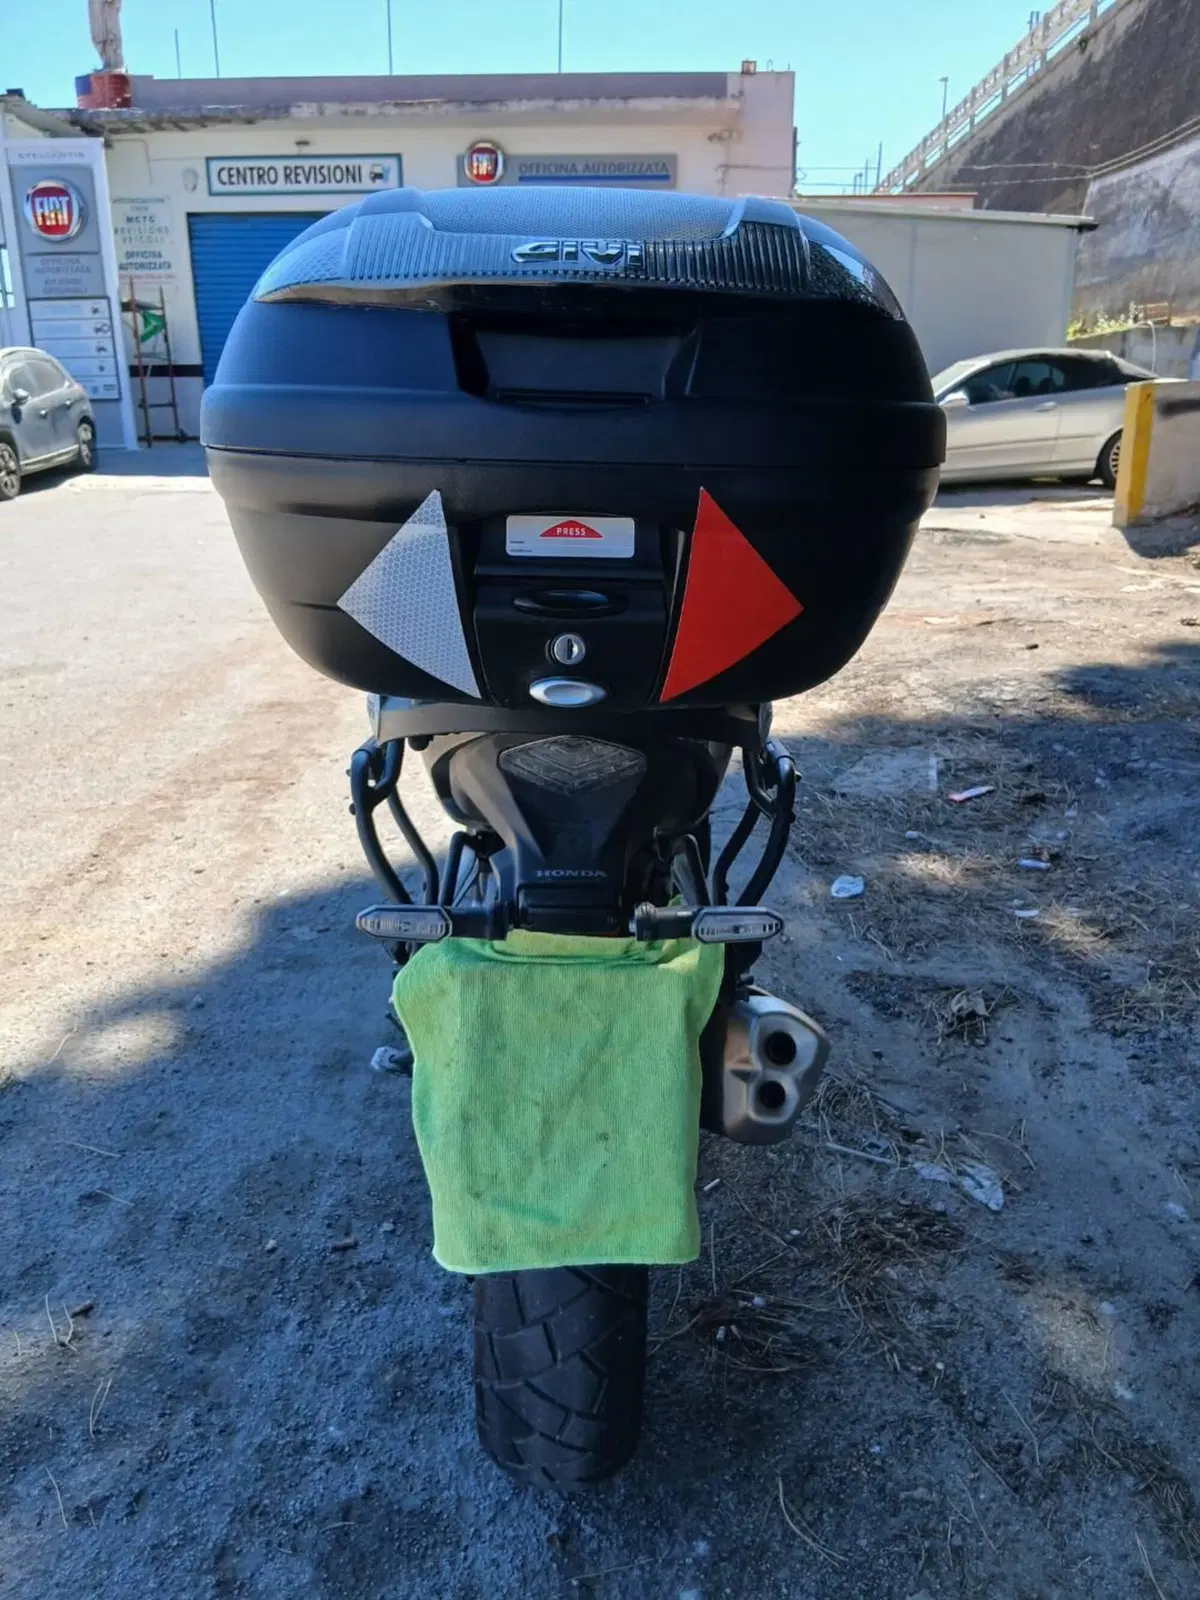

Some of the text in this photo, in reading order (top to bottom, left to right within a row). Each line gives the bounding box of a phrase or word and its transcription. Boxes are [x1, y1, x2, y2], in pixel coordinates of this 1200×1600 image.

[217, 164, 363, 186] CENTRO REVISIONI
[518, 162, 670, 175] OFFICINA AUTORIZZATA
[34, 196, 70, 226] FIAT
[510, 240, 645, 268] GIVI
[556, 527, 587, 536] PRESS
[535, 869, 608, 878] HONDA
